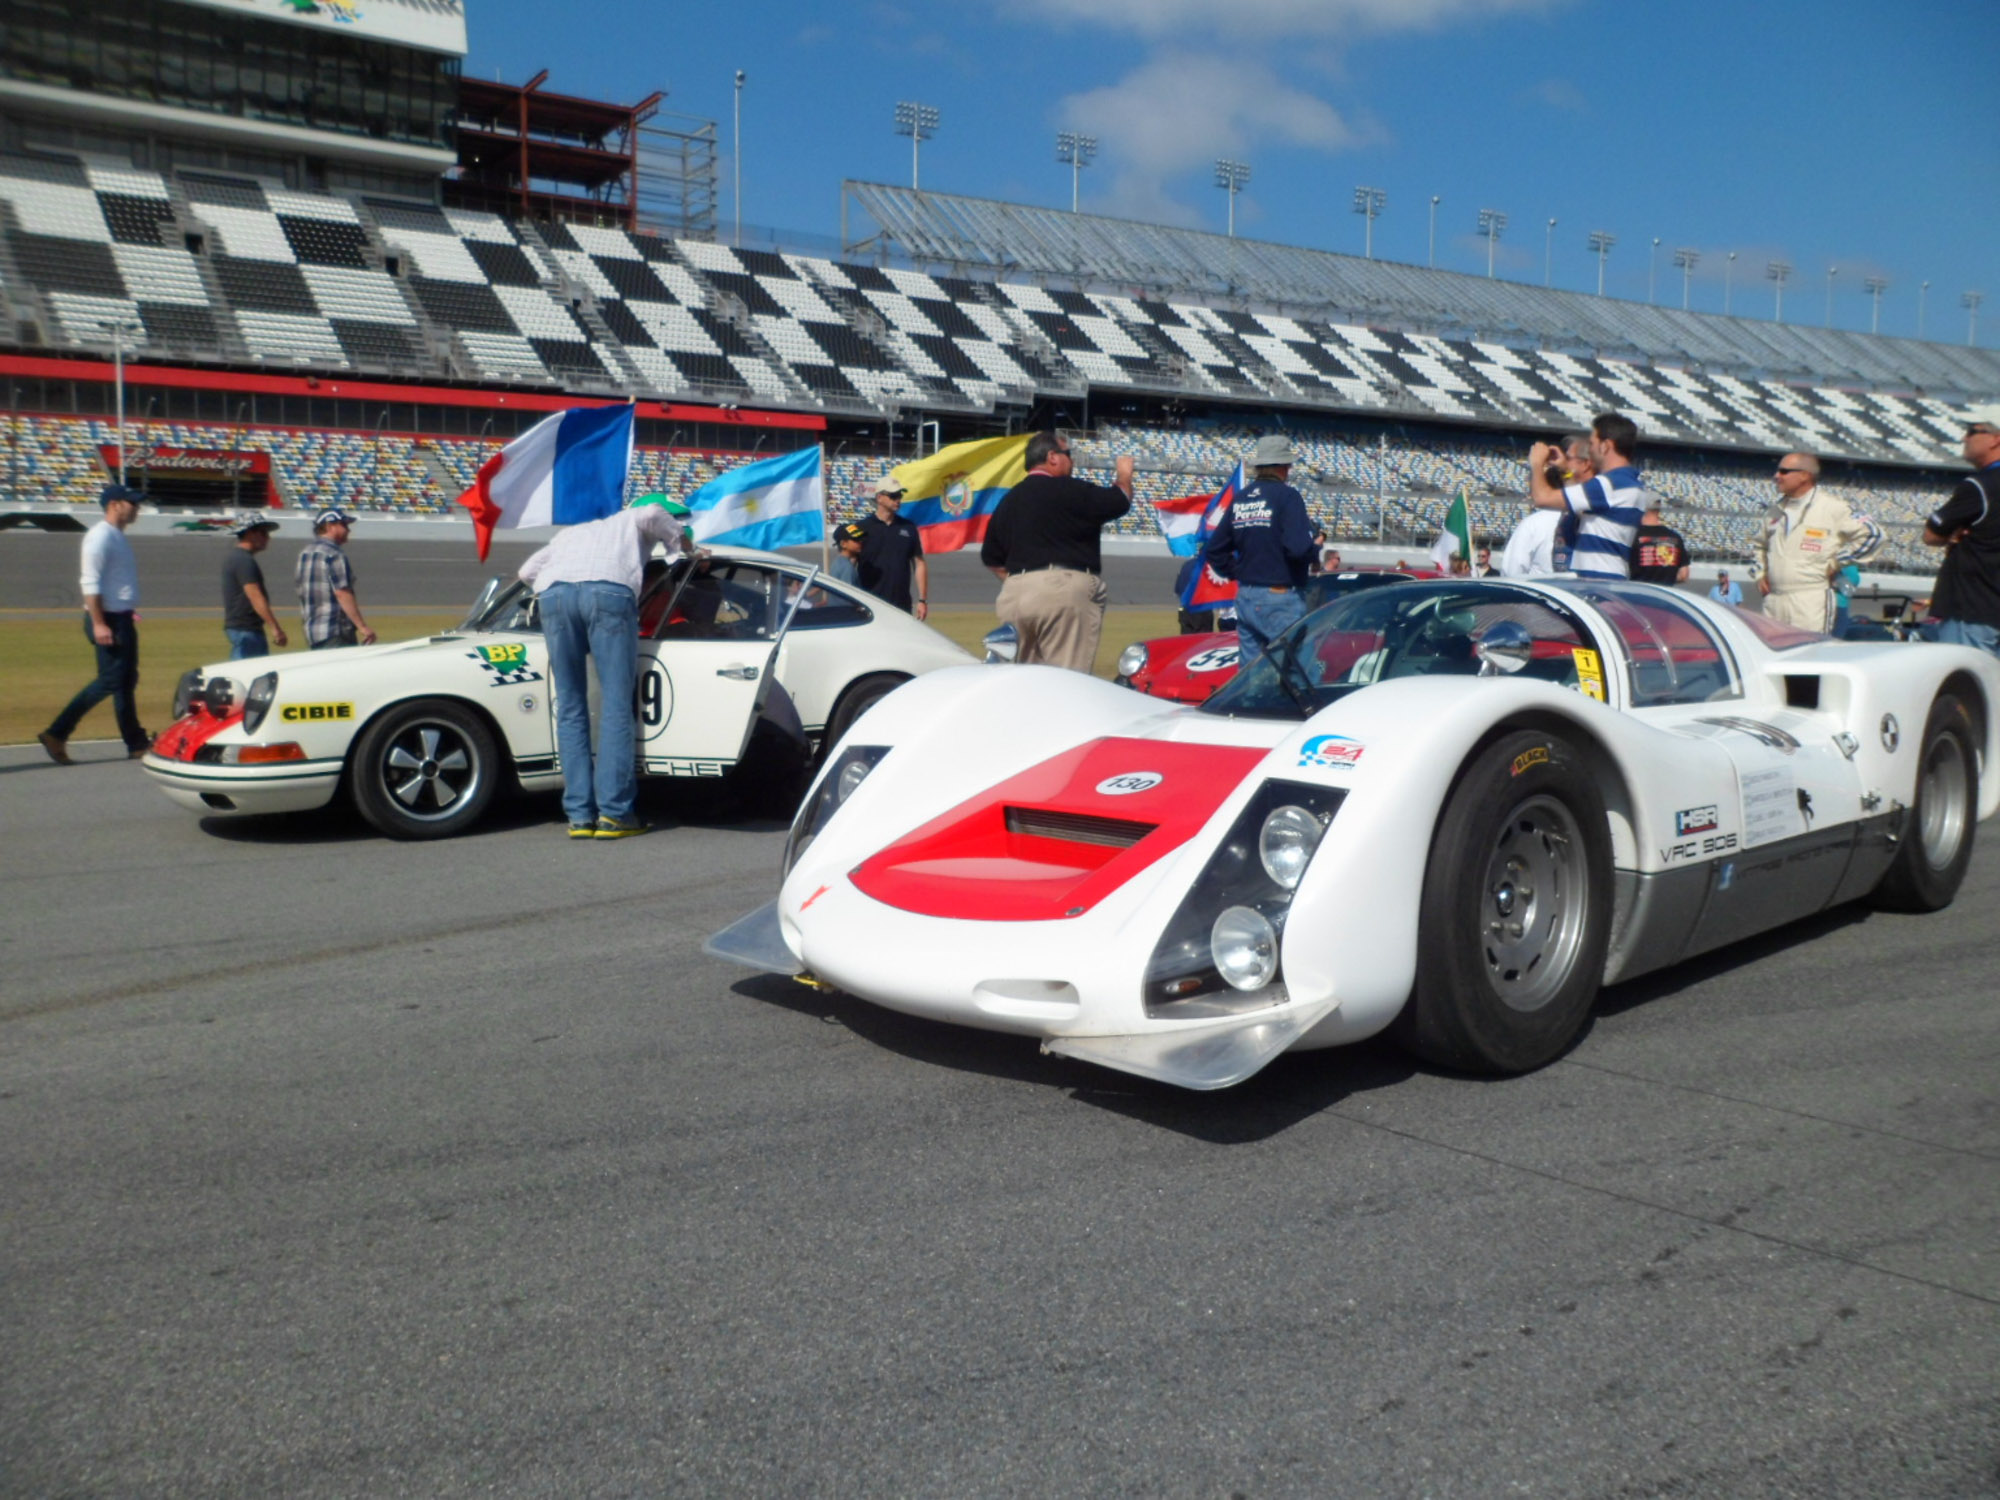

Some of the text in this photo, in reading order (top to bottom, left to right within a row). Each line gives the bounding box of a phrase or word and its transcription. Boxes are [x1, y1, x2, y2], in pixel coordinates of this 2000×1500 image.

[124, 446, 253, 470] Budweiser
[487, 644, 524, 662] BP
[1189, 649, 1240, 667] 54
[633, 670, 662, 726] 9
[1106, 777, 1156, 790] 130
[1680, 806, 1717, 832] HSR
